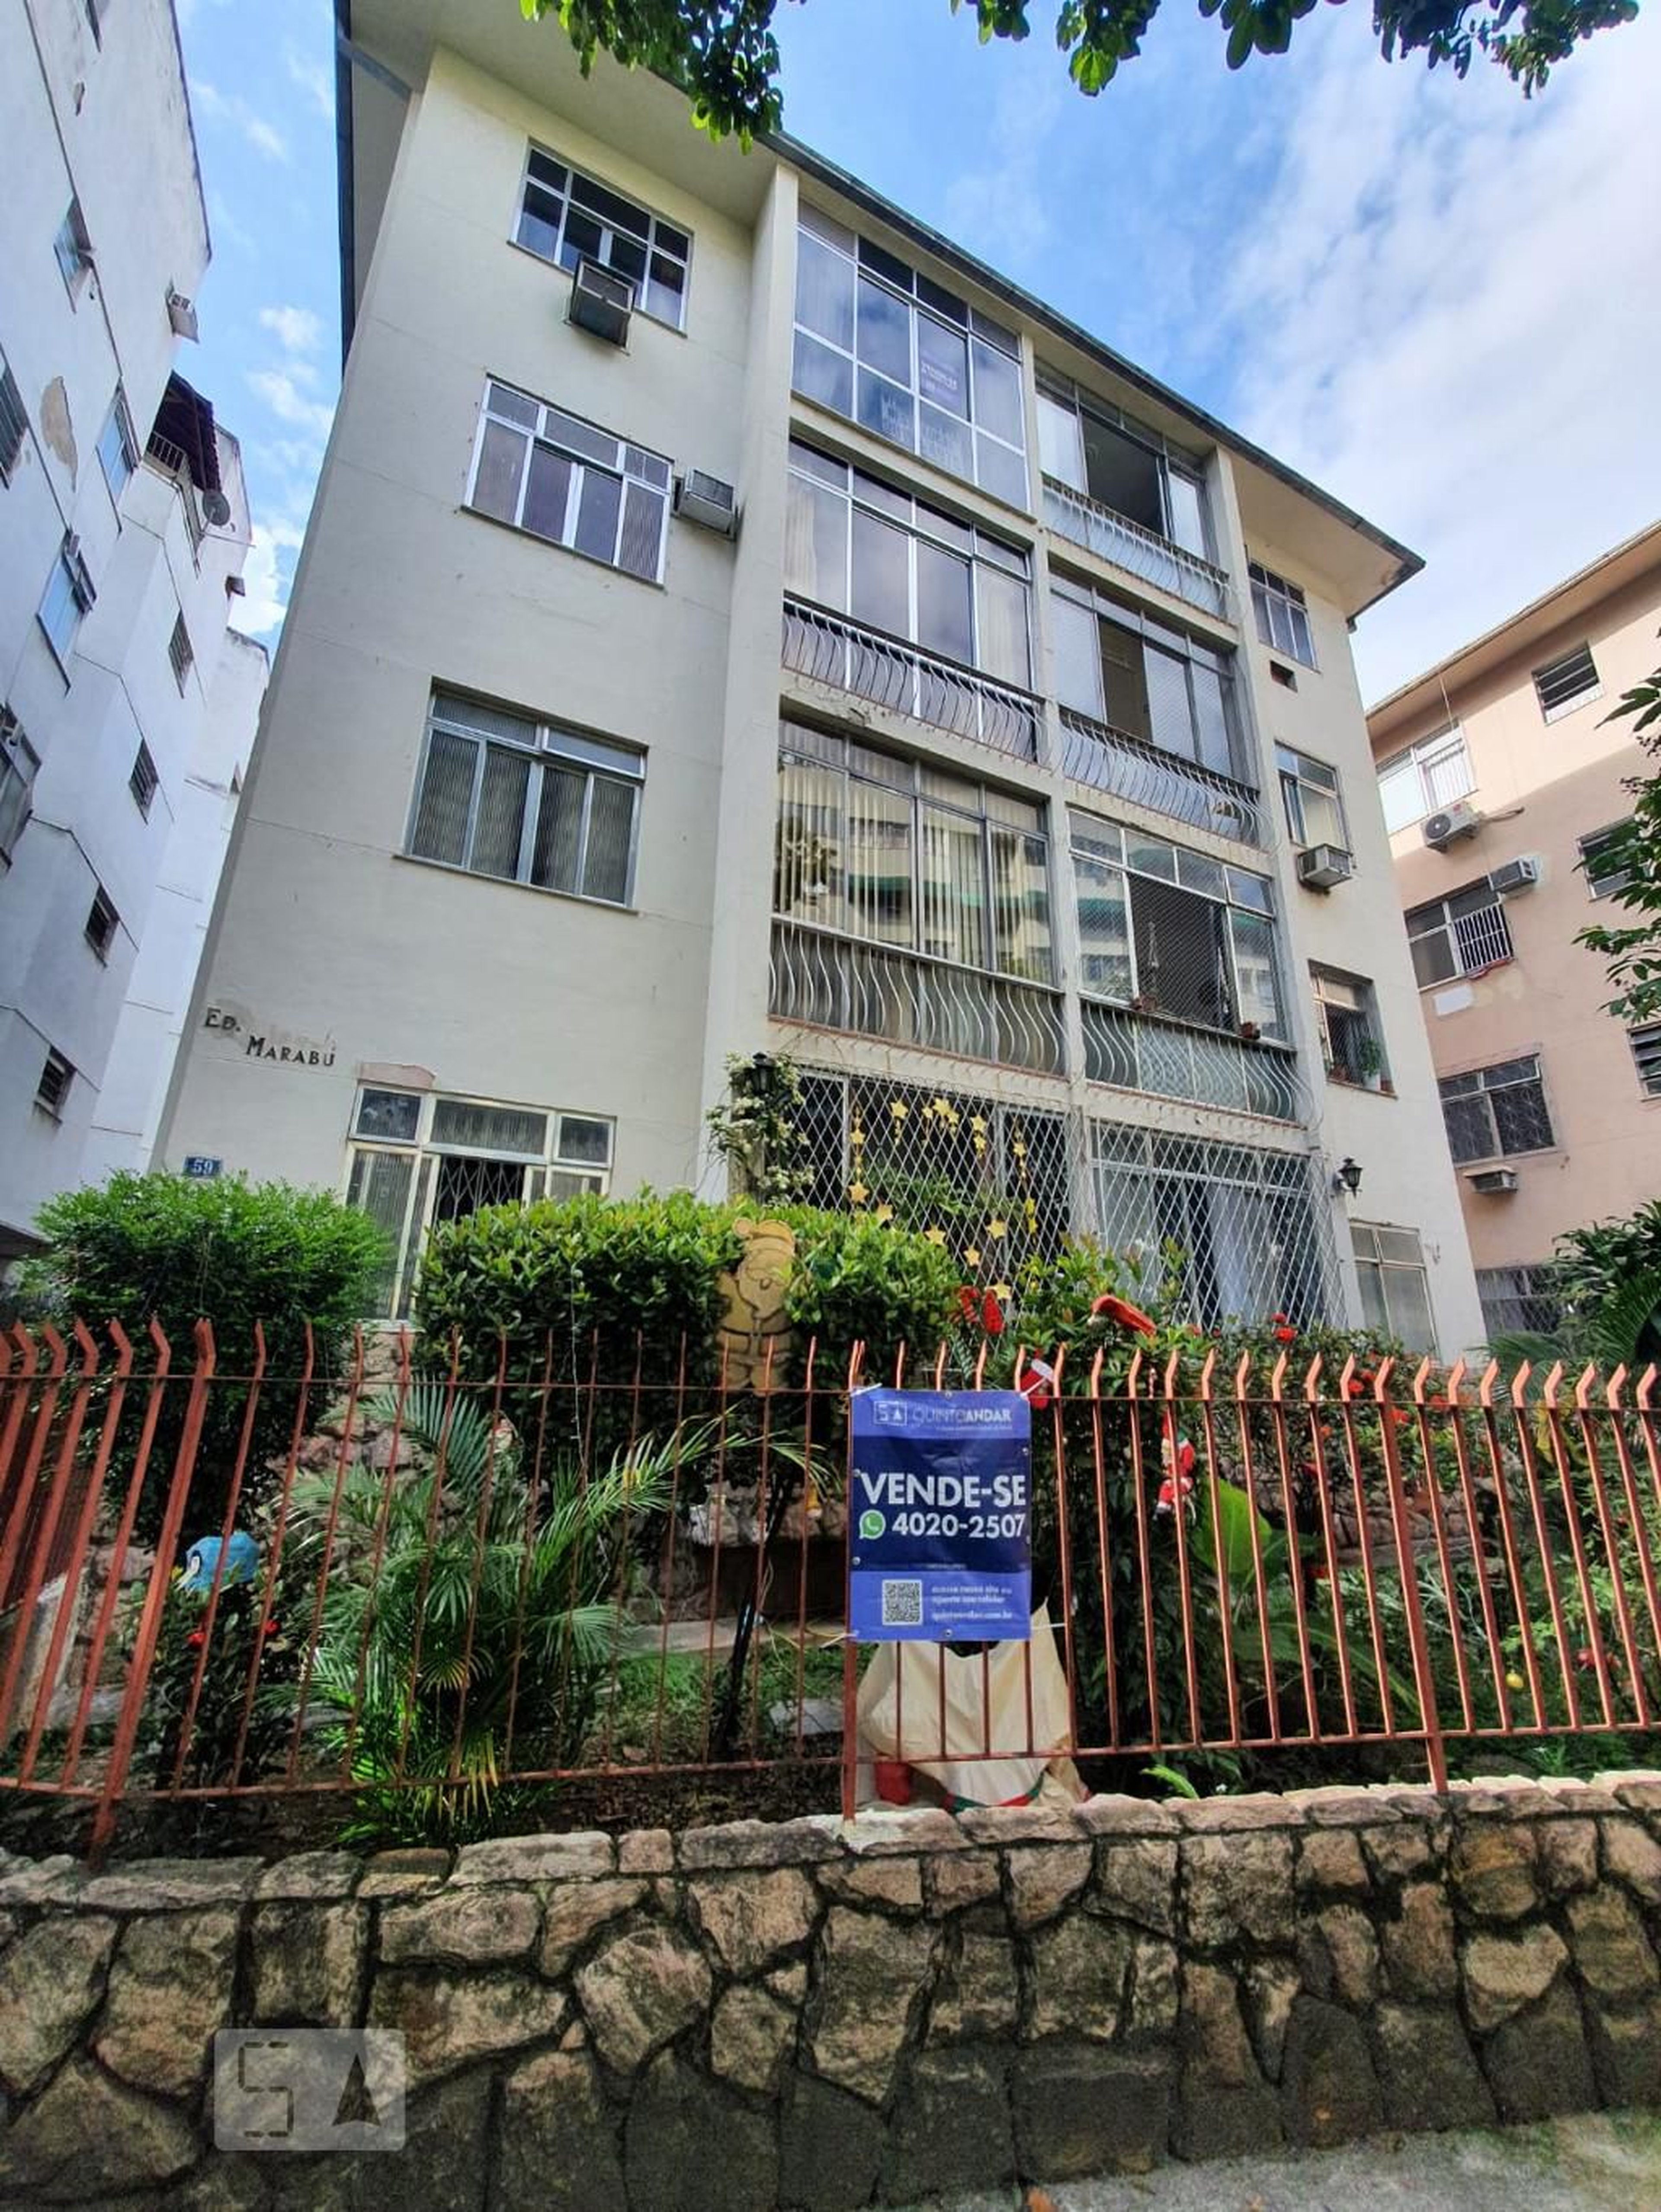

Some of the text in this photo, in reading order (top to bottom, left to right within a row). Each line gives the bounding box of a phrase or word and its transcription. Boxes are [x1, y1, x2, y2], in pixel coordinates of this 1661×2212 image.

[205, 1007, 240, 1032] ED.
[860, 1473, 1026, 1508] VENDE-SE
[892, 1512, 1026, 1538] 4020-2507
